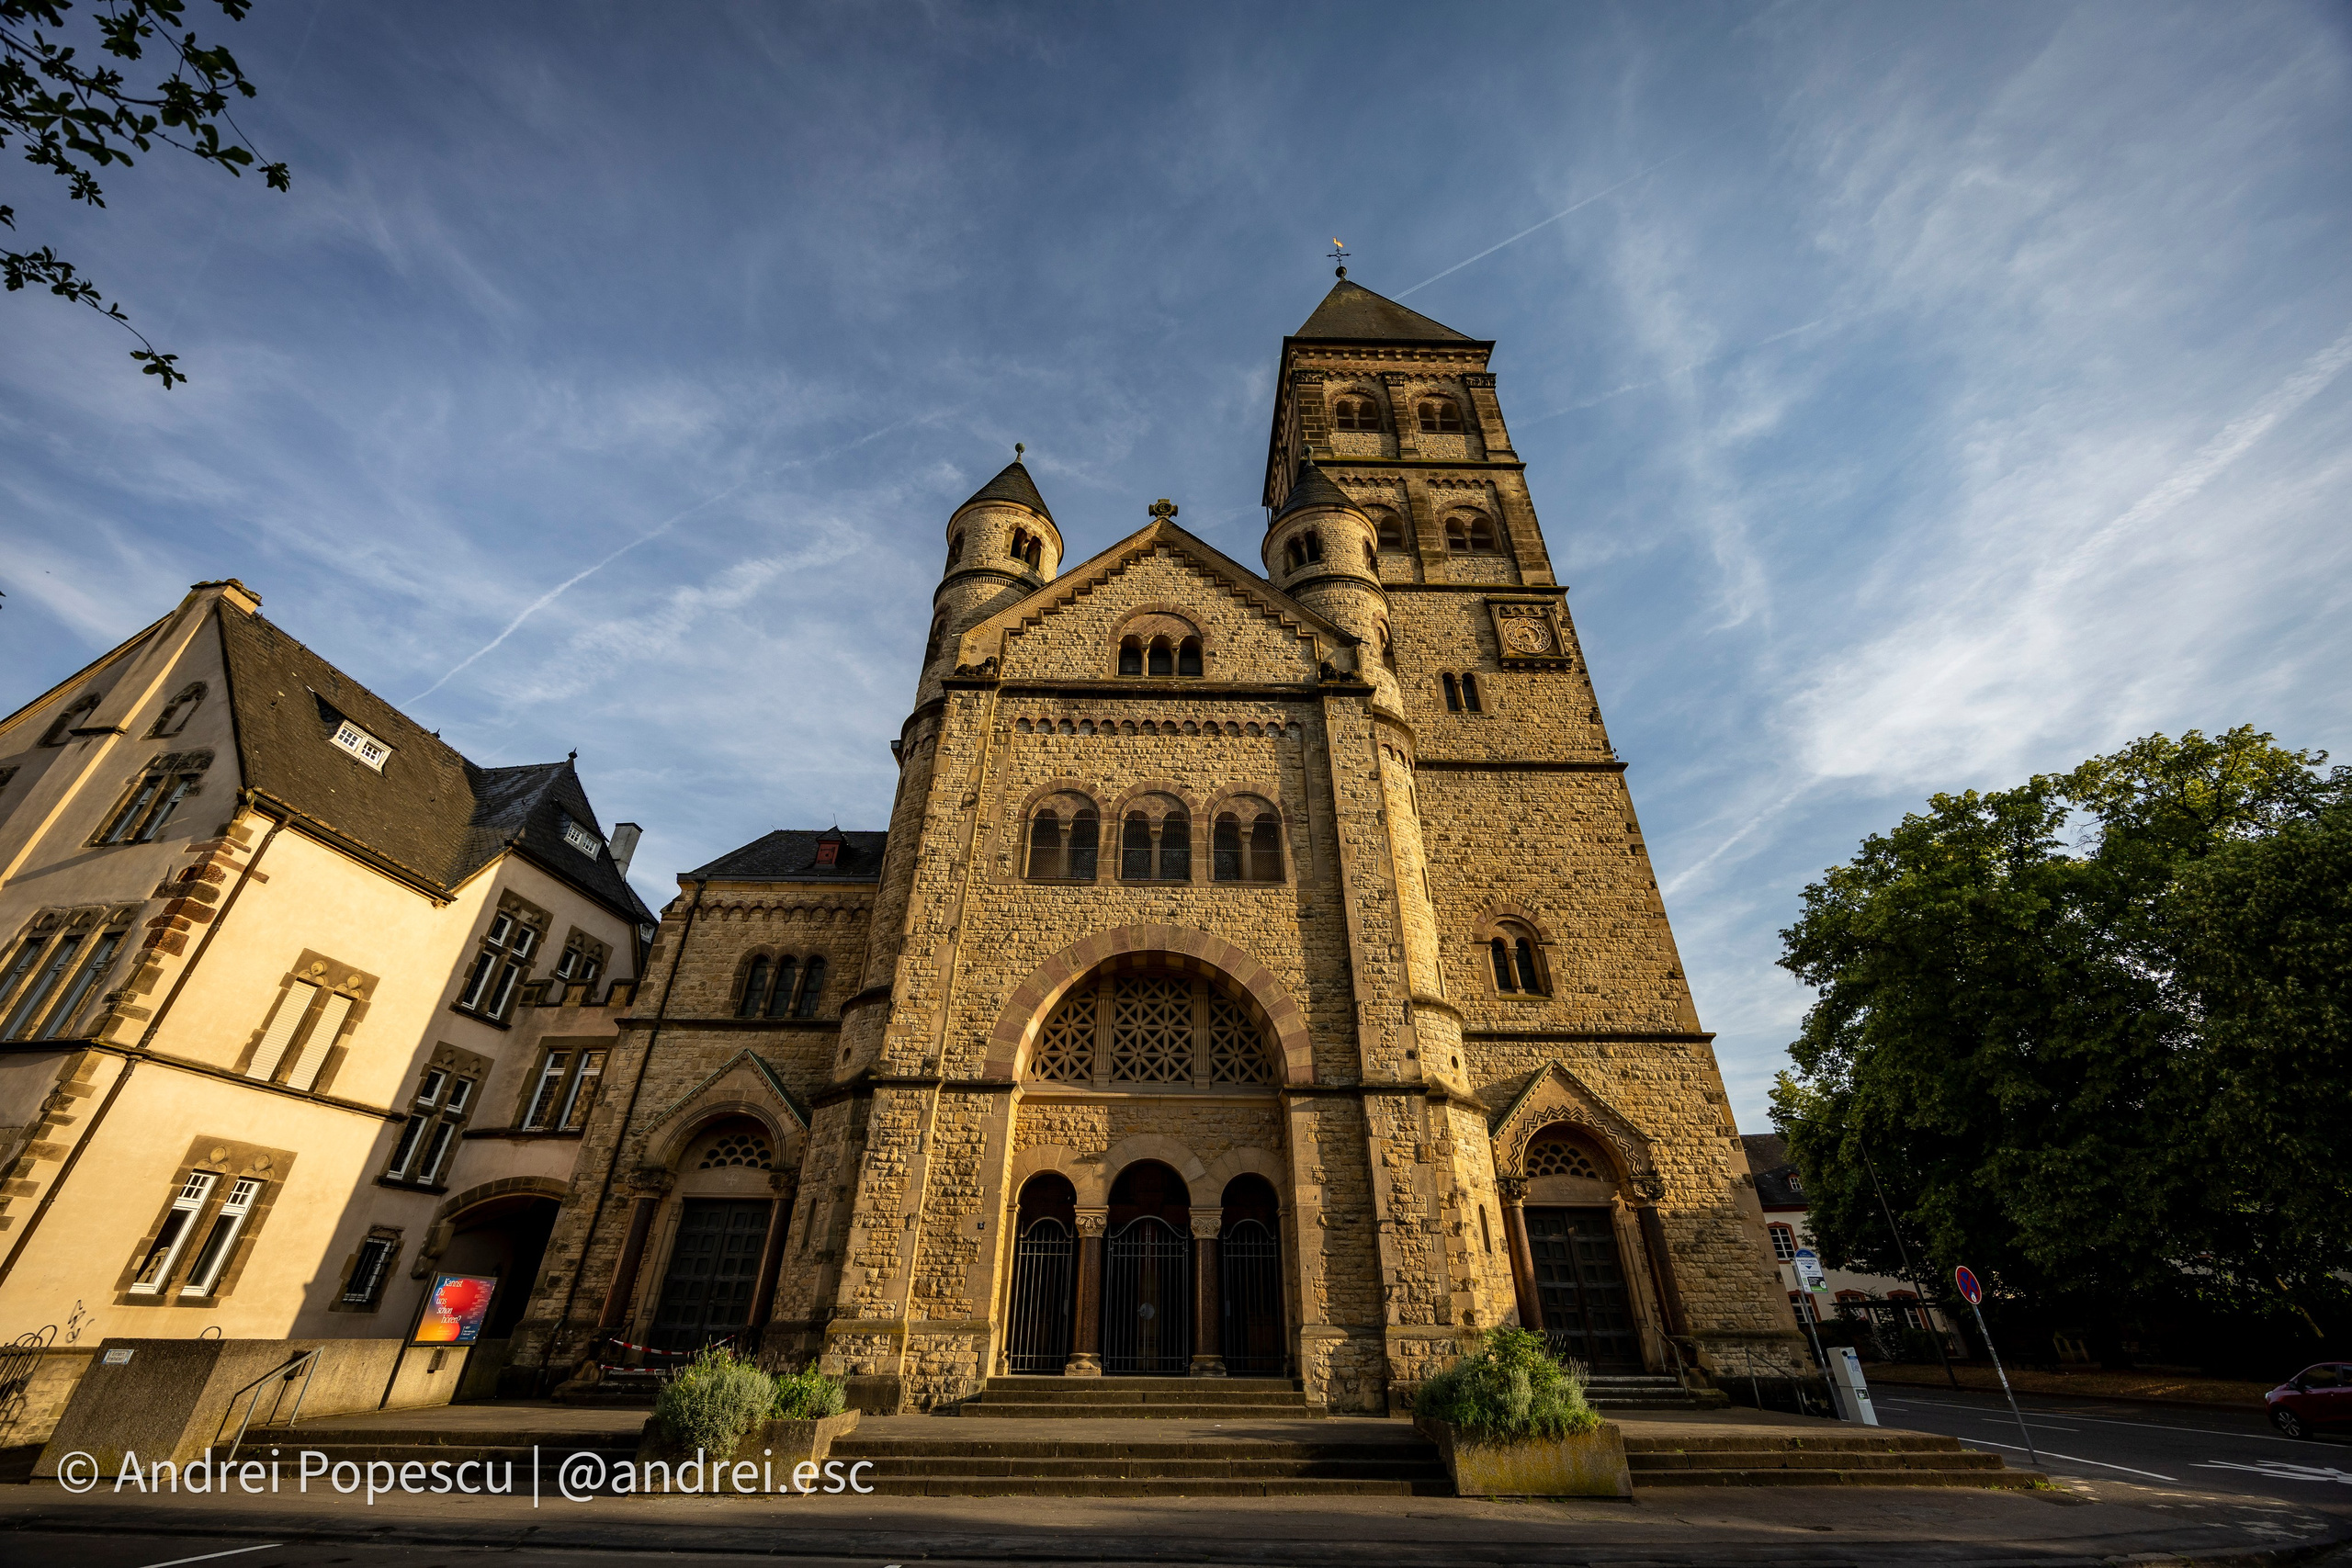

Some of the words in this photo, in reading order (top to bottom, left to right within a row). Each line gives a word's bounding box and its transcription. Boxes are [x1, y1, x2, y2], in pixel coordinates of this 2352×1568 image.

[443, 1278, 463, 1287] Kannst
[436, 1288, 445, 1296] Du
[437, 1305, 453, 1314] schon
[441, 1314, 462, 1323] hören?
